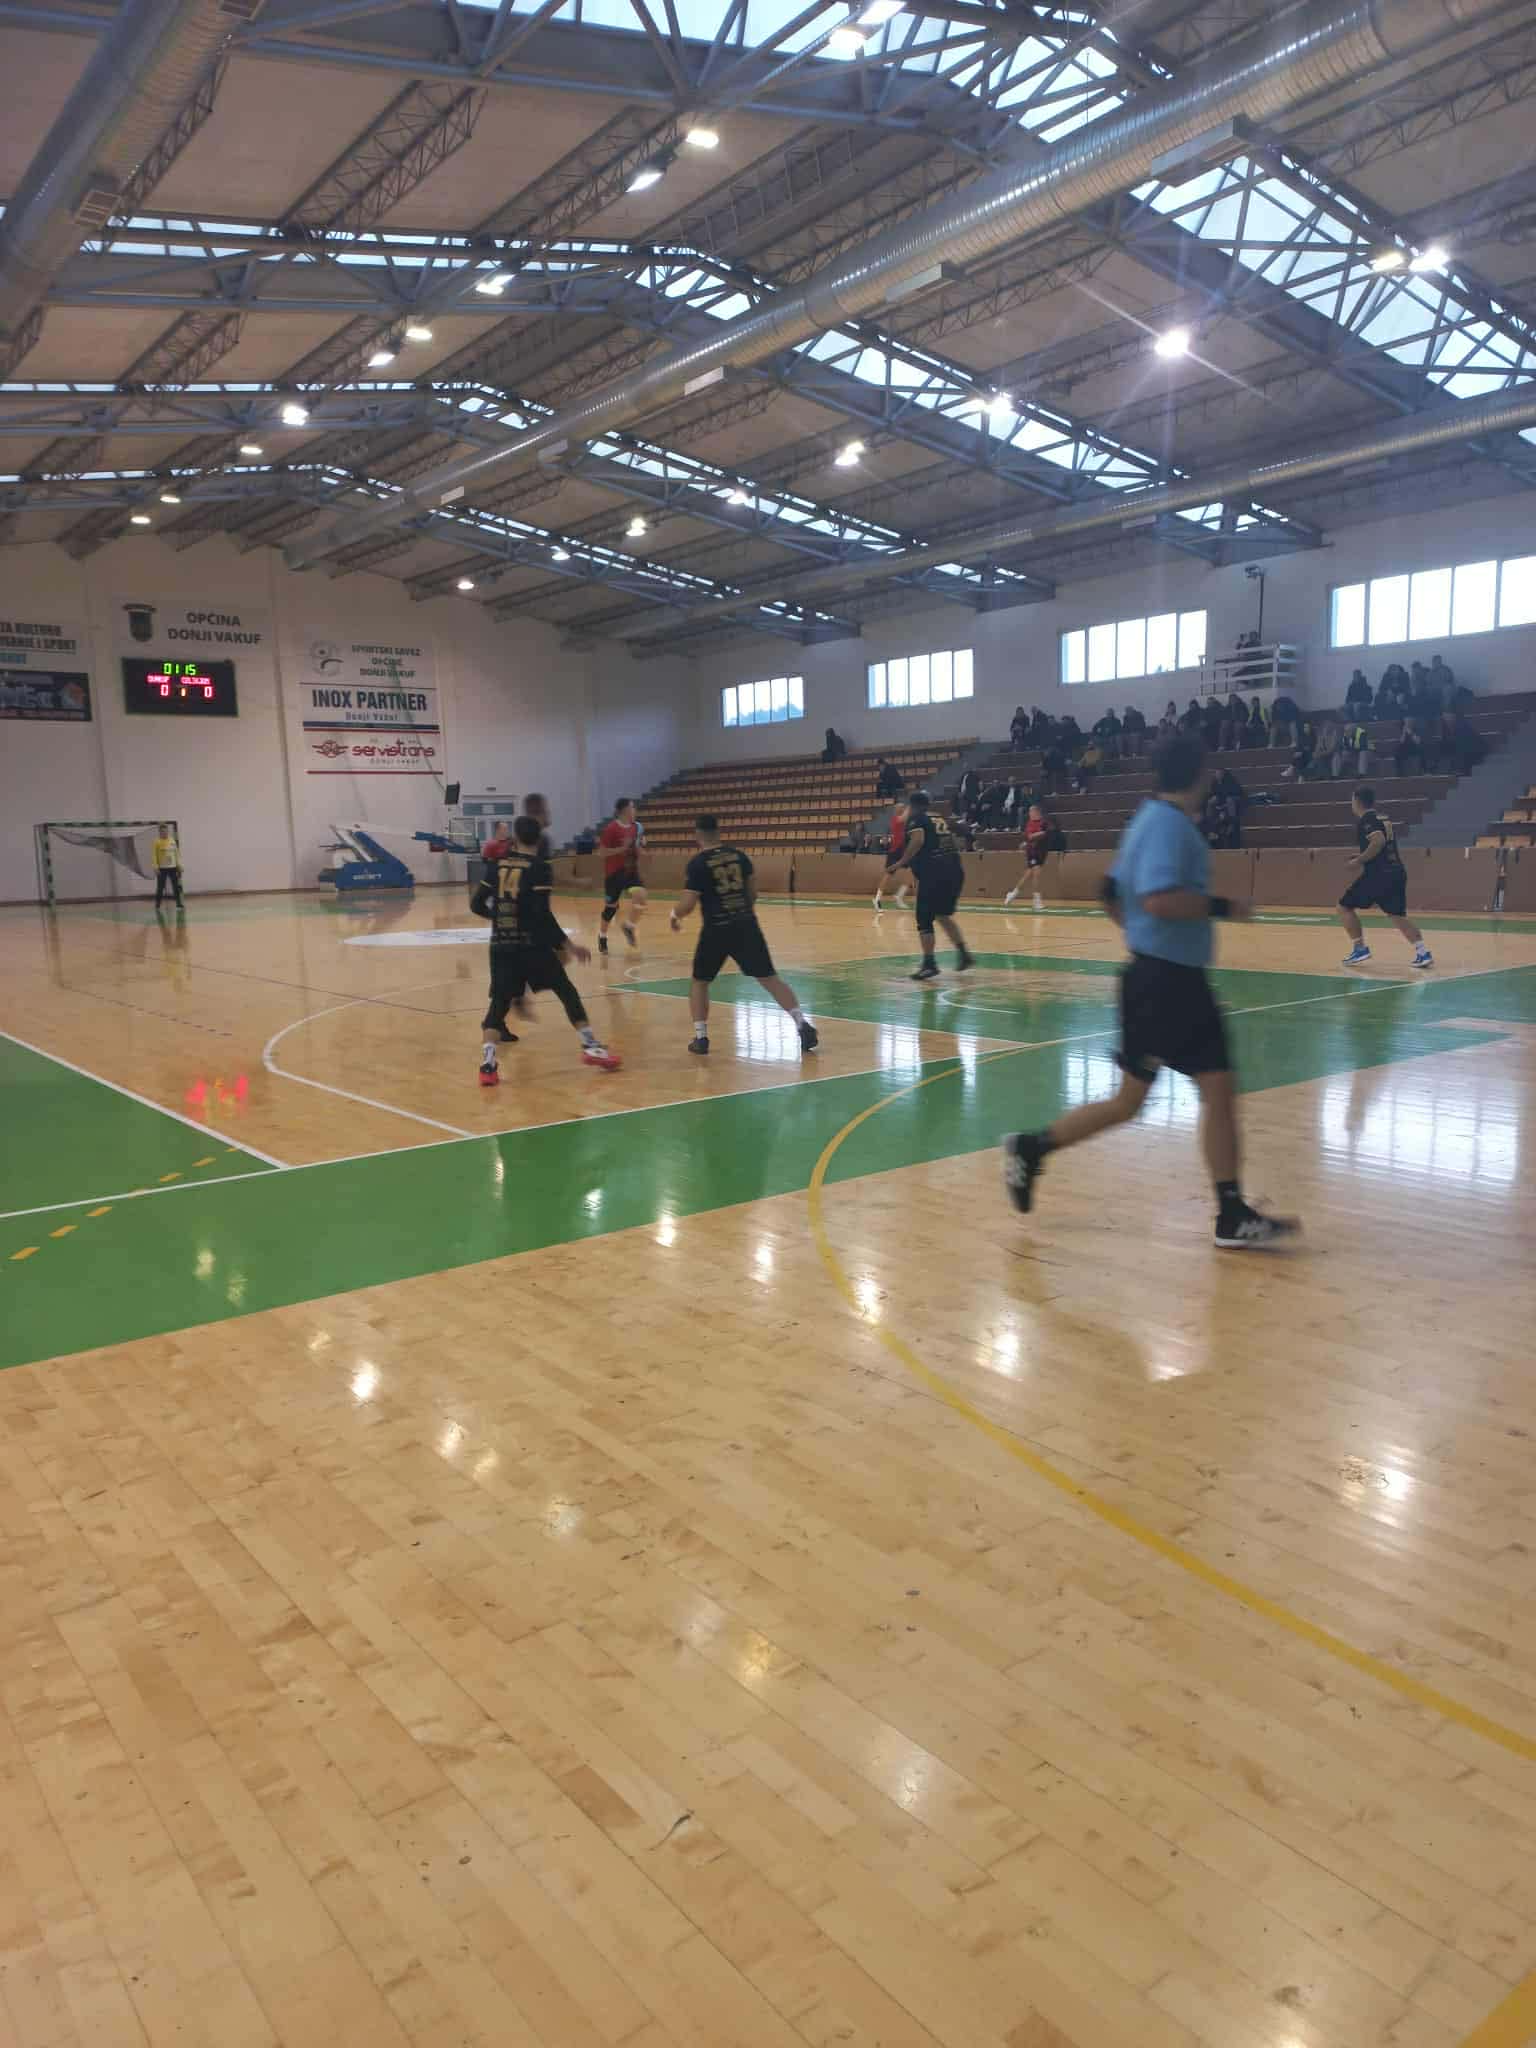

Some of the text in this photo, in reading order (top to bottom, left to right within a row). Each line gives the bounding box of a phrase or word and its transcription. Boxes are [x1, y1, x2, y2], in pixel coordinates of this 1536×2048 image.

[167, 628, 261, 645] DONJI VAKUF
[161, 685, 169, 696] 0
[204, 687, 213, 698] 0
[312, 689, 428, 711] INOX PARTNER
